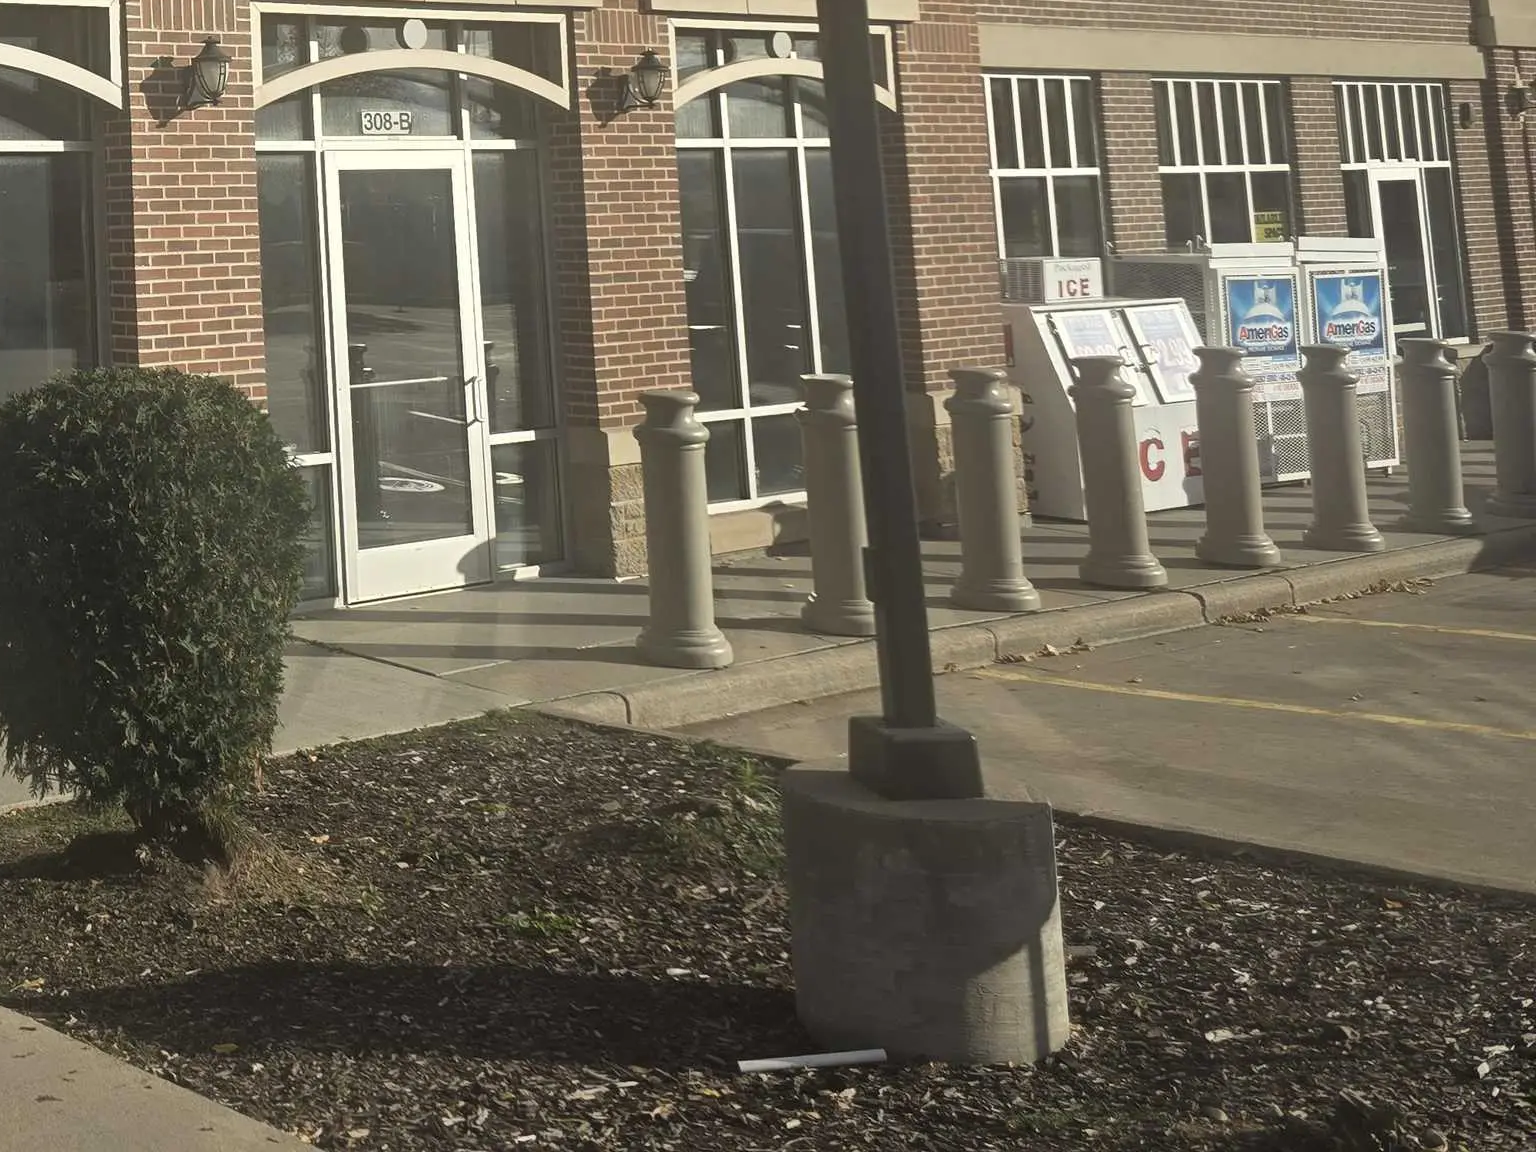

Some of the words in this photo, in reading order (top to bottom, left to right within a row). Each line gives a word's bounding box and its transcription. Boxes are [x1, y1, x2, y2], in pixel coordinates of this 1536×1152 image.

[364, 112, 411, 130] 308-B
[1057, 278, 1090, 298] ICE
[1239, 325, 1289, 341] AmeriGas
[1326, 320, 1376, 337] AmeriGas
[1139, 428, 1202, 482] CE
